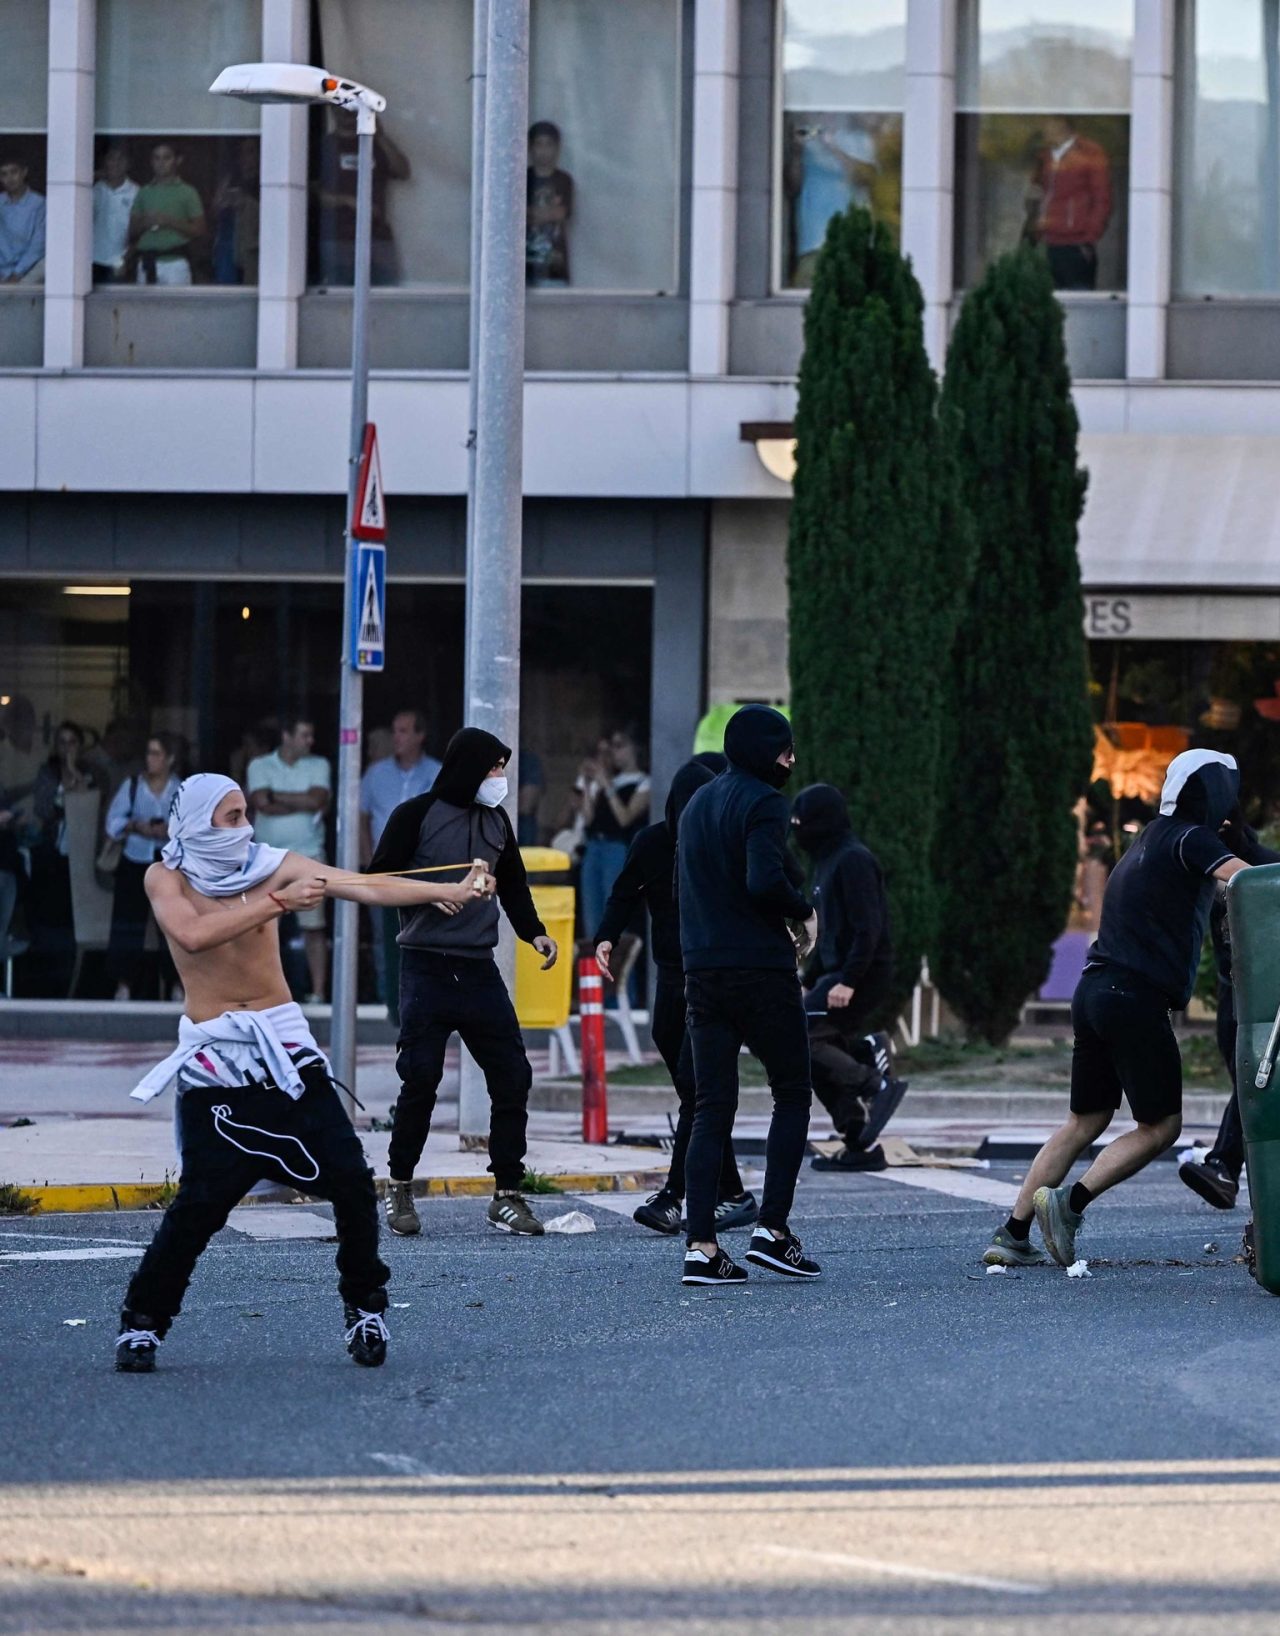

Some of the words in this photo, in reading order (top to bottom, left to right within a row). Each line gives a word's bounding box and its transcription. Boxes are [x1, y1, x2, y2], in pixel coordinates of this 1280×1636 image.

[1084, 600, 1132, 635] ES
[785, 1245, 803, 1266] N
[718, 1259, 734, 1279] N
